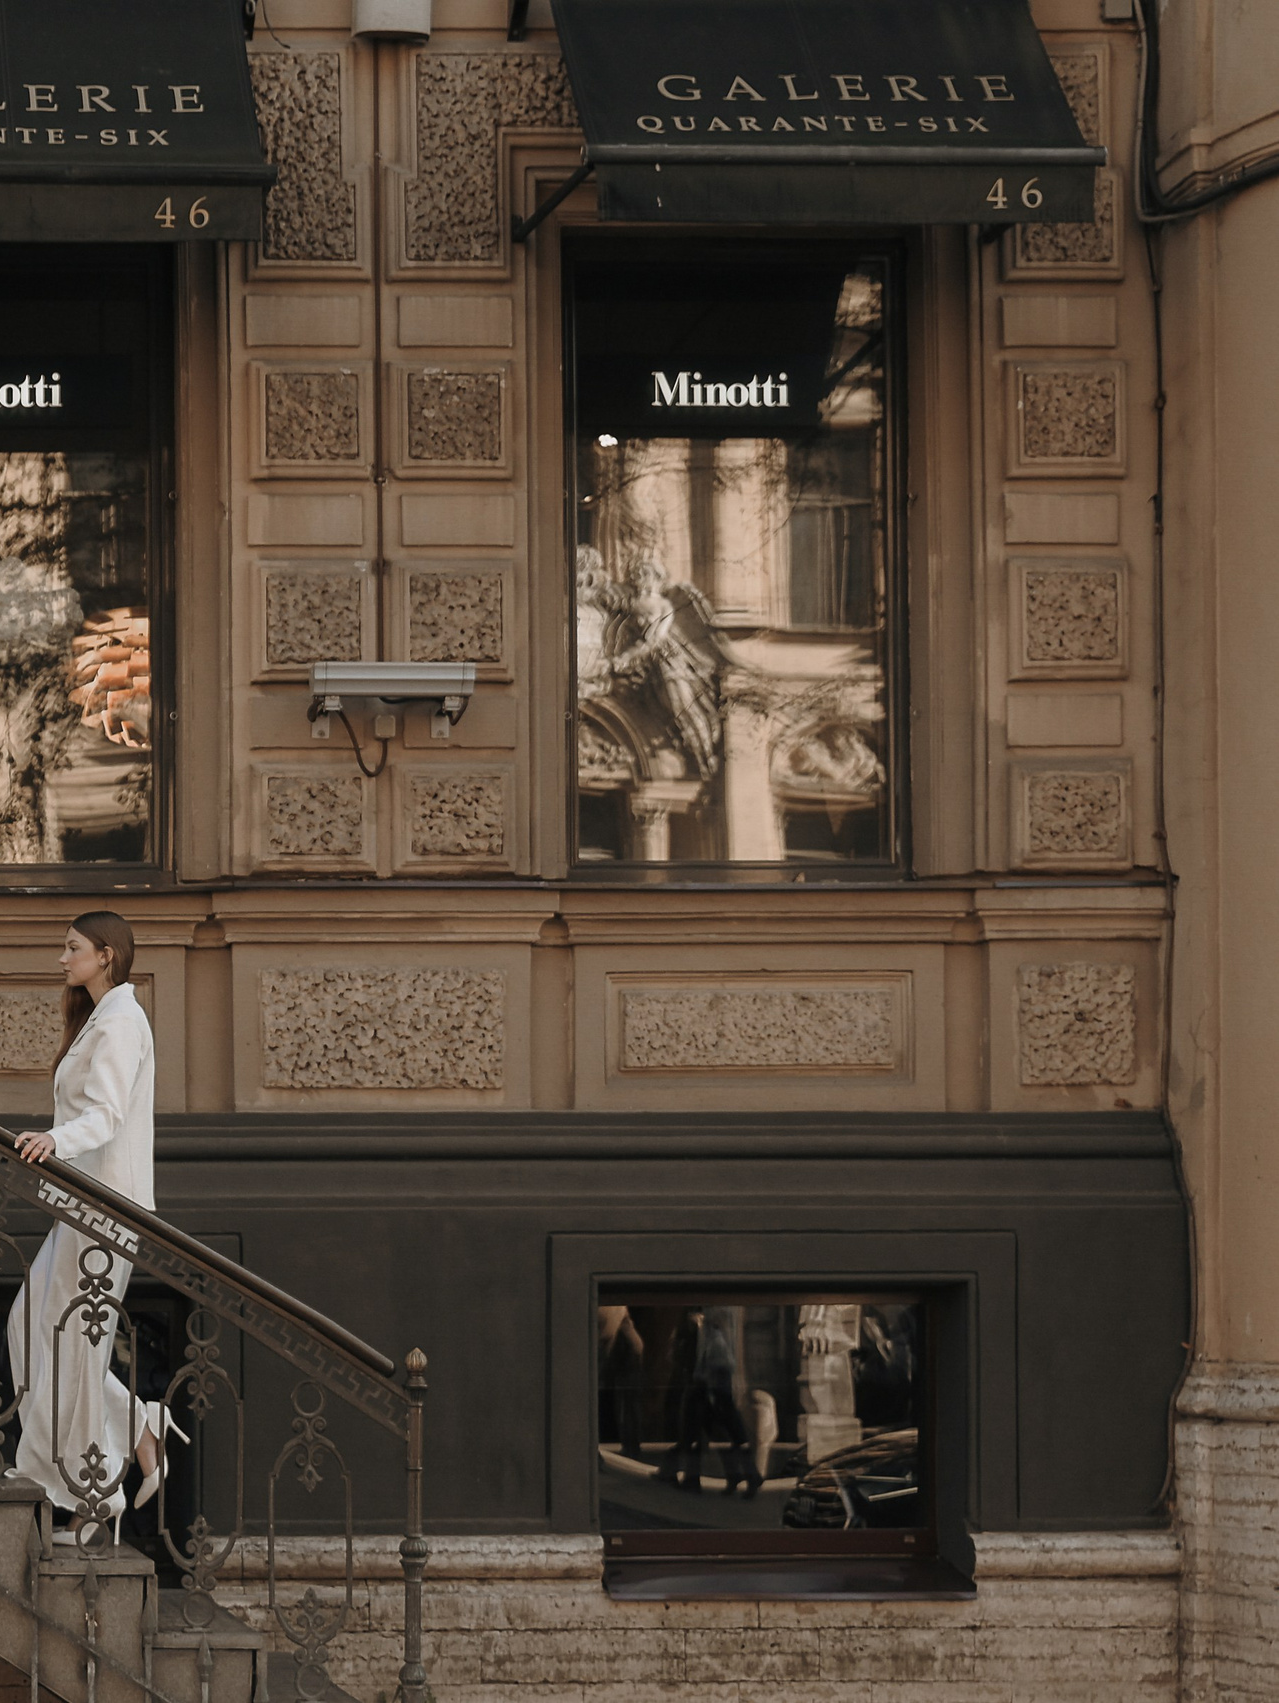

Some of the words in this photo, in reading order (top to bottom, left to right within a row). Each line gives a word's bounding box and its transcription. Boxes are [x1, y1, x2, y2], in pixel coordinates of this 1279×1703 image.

[656, 74, 1016, 102] GALERIE
[635, 115, 991, 134] QUARANTE-SIX
[651, 371, 791, 408] Minotti
